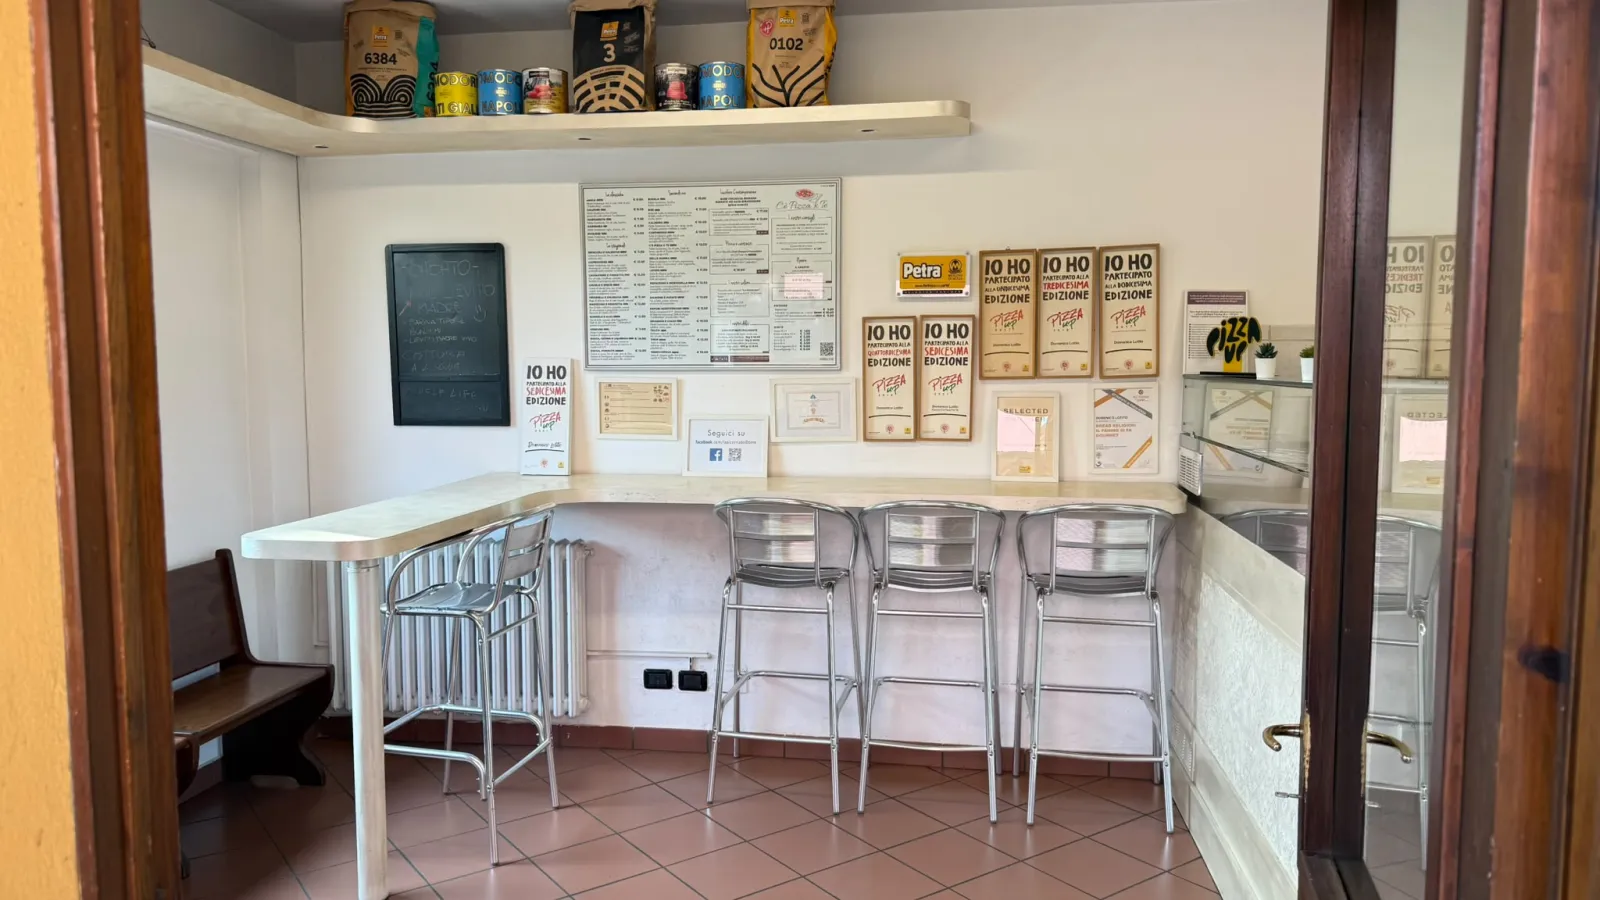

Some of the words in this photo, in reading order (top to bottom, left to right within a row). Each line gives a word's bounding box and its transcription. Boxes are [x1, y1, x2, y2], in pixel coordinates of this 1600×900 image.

[769, 37, 804, 51] 0102
[603, 43, 616, 63] 3
[364, 53, 398, 65] 6384
[985, 259, 1002, 275] IO
[1008, 258, 1030, 275] HO
[1043, 257, 1061, 273] IO
[1066, 256, 1089, 272] HO
[1105, 255, 1123, 272] IO
[1128, 254, 1152, 270] HO
[902, 262, 942, 279] Petra
[1105, 271, 1152, 280] PARTECIPATO
[985, 275, 1030, 284] PARTECIPATO
[1117, 280, 1152, 289] DODICESIMA
[997, 285, 1030, 293] UNDICESIMA
[1043, 281, 1089, 290] TREDICESIMA
[985, 294, 1030, 304] EDIZIONE
[1043, 290, 1089, 301] EDIZIONE
[1105, 289, 1152, 301] EDIZIONE
[868, 325, 884, 341] IO
[889, 324, 911, 340] HO
[925, 323, 942, 339] IO
[947, 323, 969, 339] HO
[925, 346, 968, 356] SEDICESIMA
[868, 357, 911, 367] EDIZIONE
[925, 357, 968, 366] EDIZIONE
[526, 365, 542, 380] IO
[546, 365, 566, 380] HO
[526, 387, 566, 396] SEDICESIMA
[526, 397, 566, 406] EDIZIONE
[708, 428, 735, 438] Seguici
